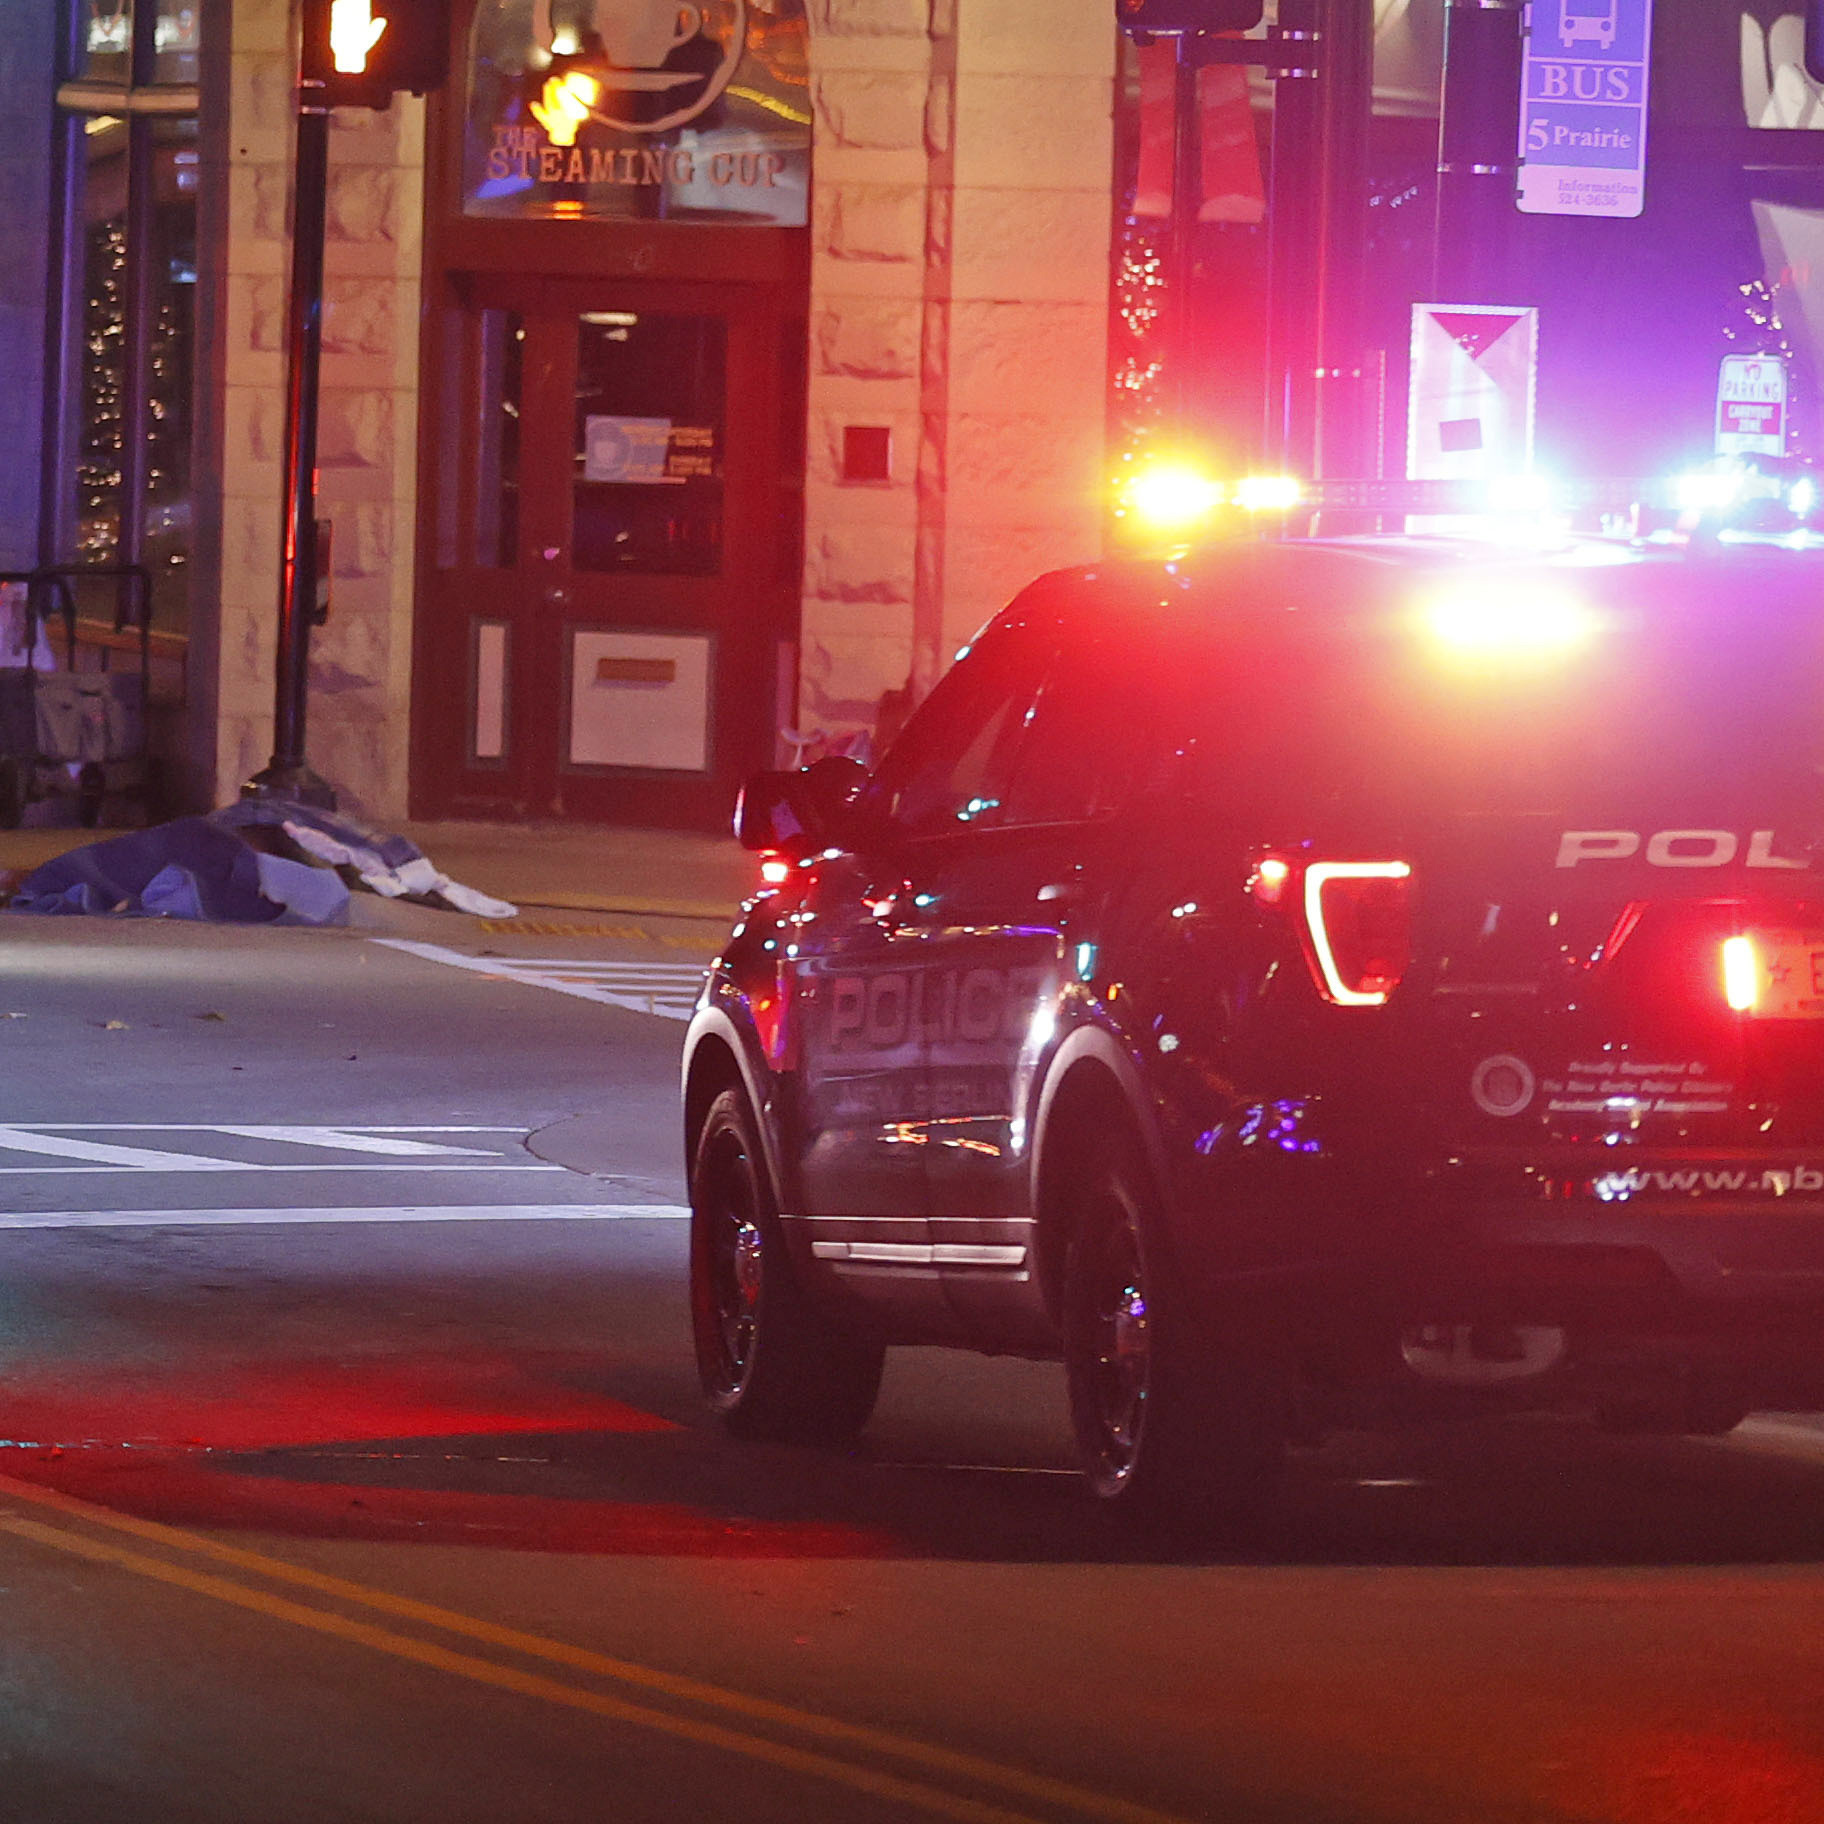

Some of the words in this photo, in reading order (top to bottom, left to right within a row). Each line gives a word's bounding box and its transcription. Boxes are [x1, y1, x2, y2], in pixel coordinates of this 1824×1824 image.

[1539, 64, 1630, 101] BUS
[1527, 118, 1550, 151] 5
[1553, 125, 1633, 149] Prairie
[488, 146, 695, 185] STEAMING
[707, 152, 783, 188] CUP
[1558, 178, 1639, 195] Information
[1724, 380, 1781, 401] PARKING
[1555, 829, 1816, 869] POL
